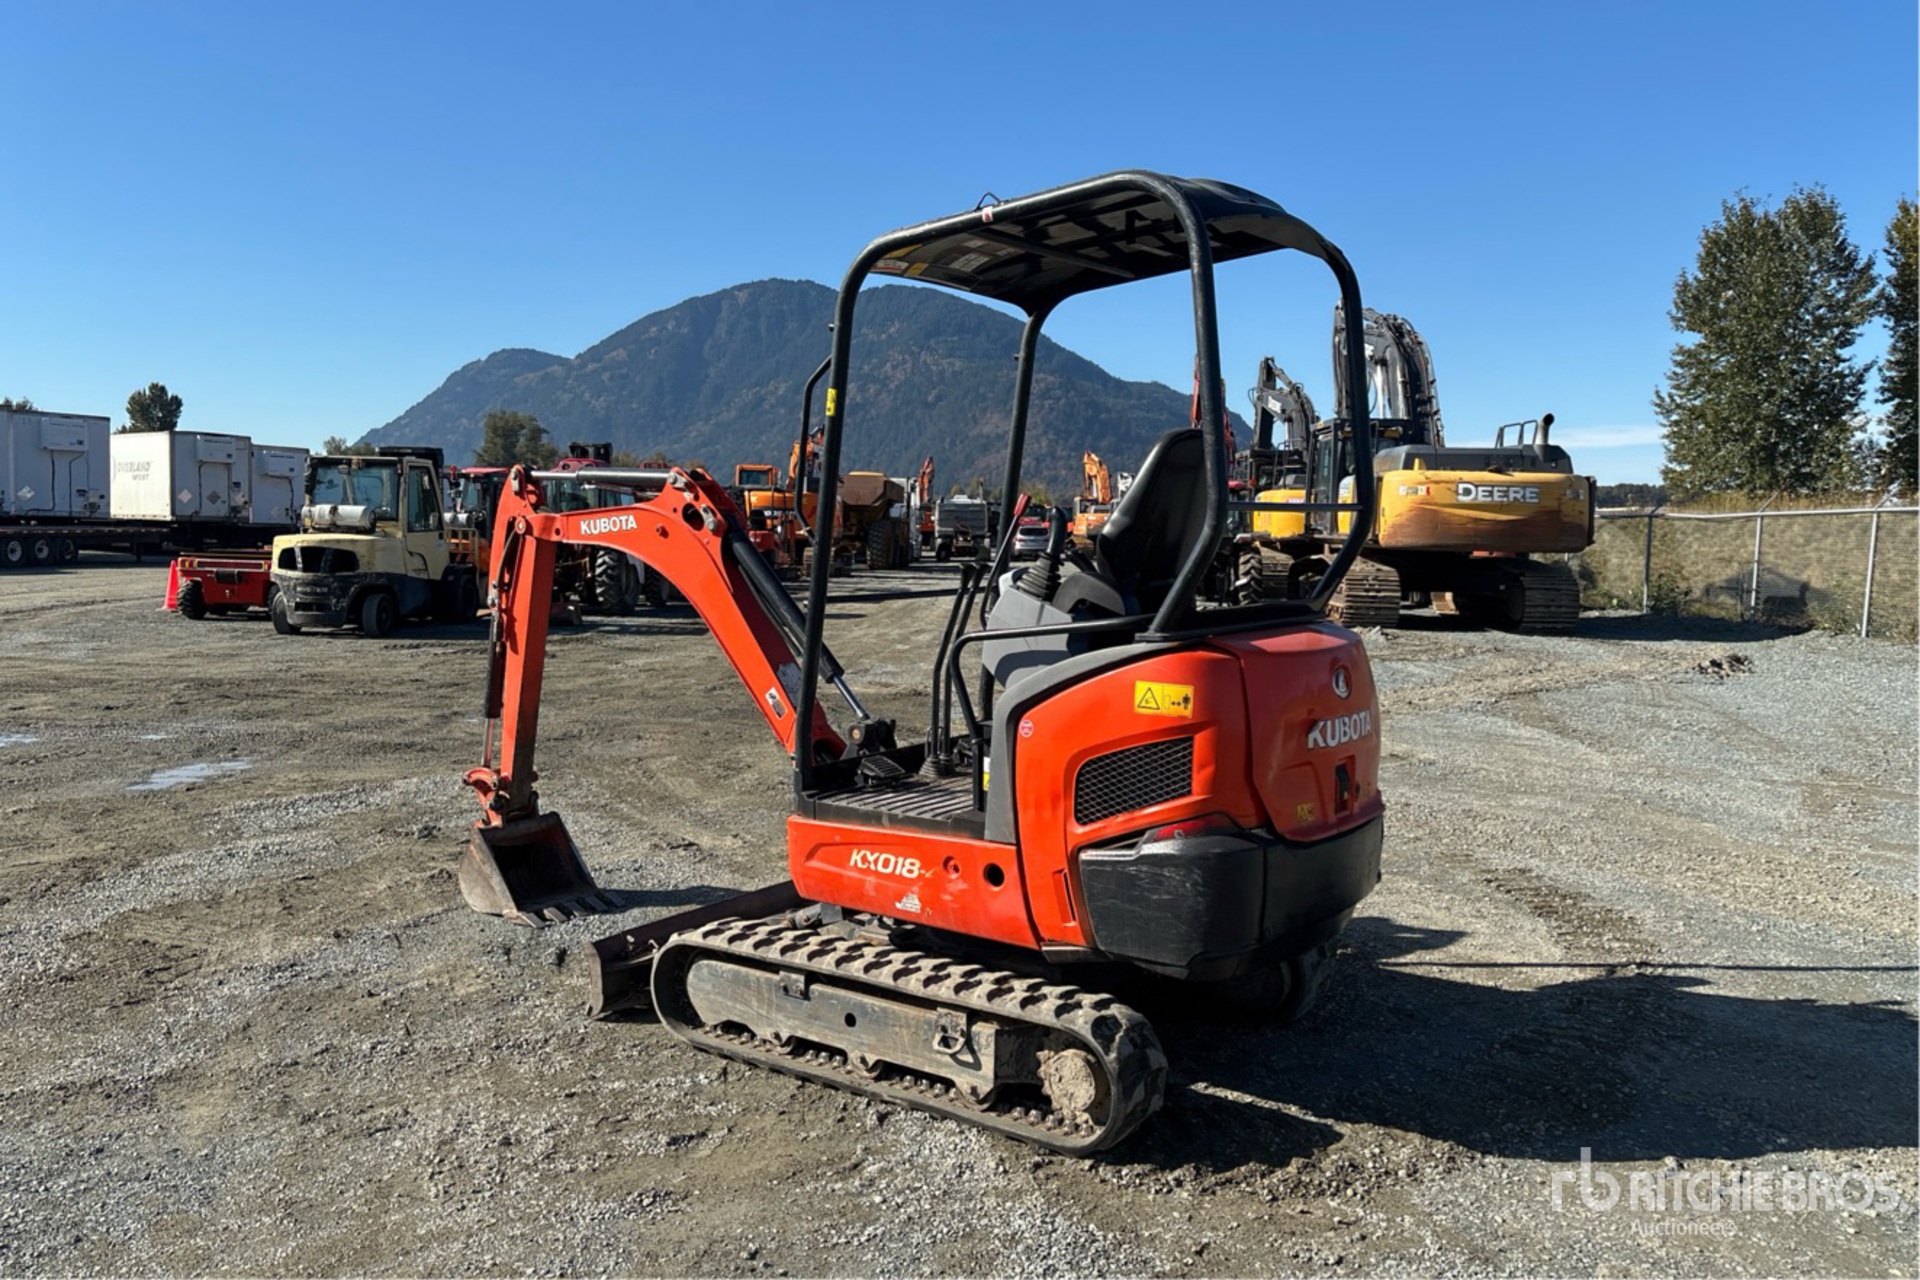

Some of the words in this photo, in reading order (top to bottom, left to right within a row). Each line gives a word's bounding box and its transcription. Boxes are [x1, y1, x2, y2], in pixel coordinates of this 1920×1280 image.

[1457, 482, 1540, 503] DEERE
[580, 514, 638, 535] KUBOTA
[1307, 709, 1372, 749] KUBOTA
